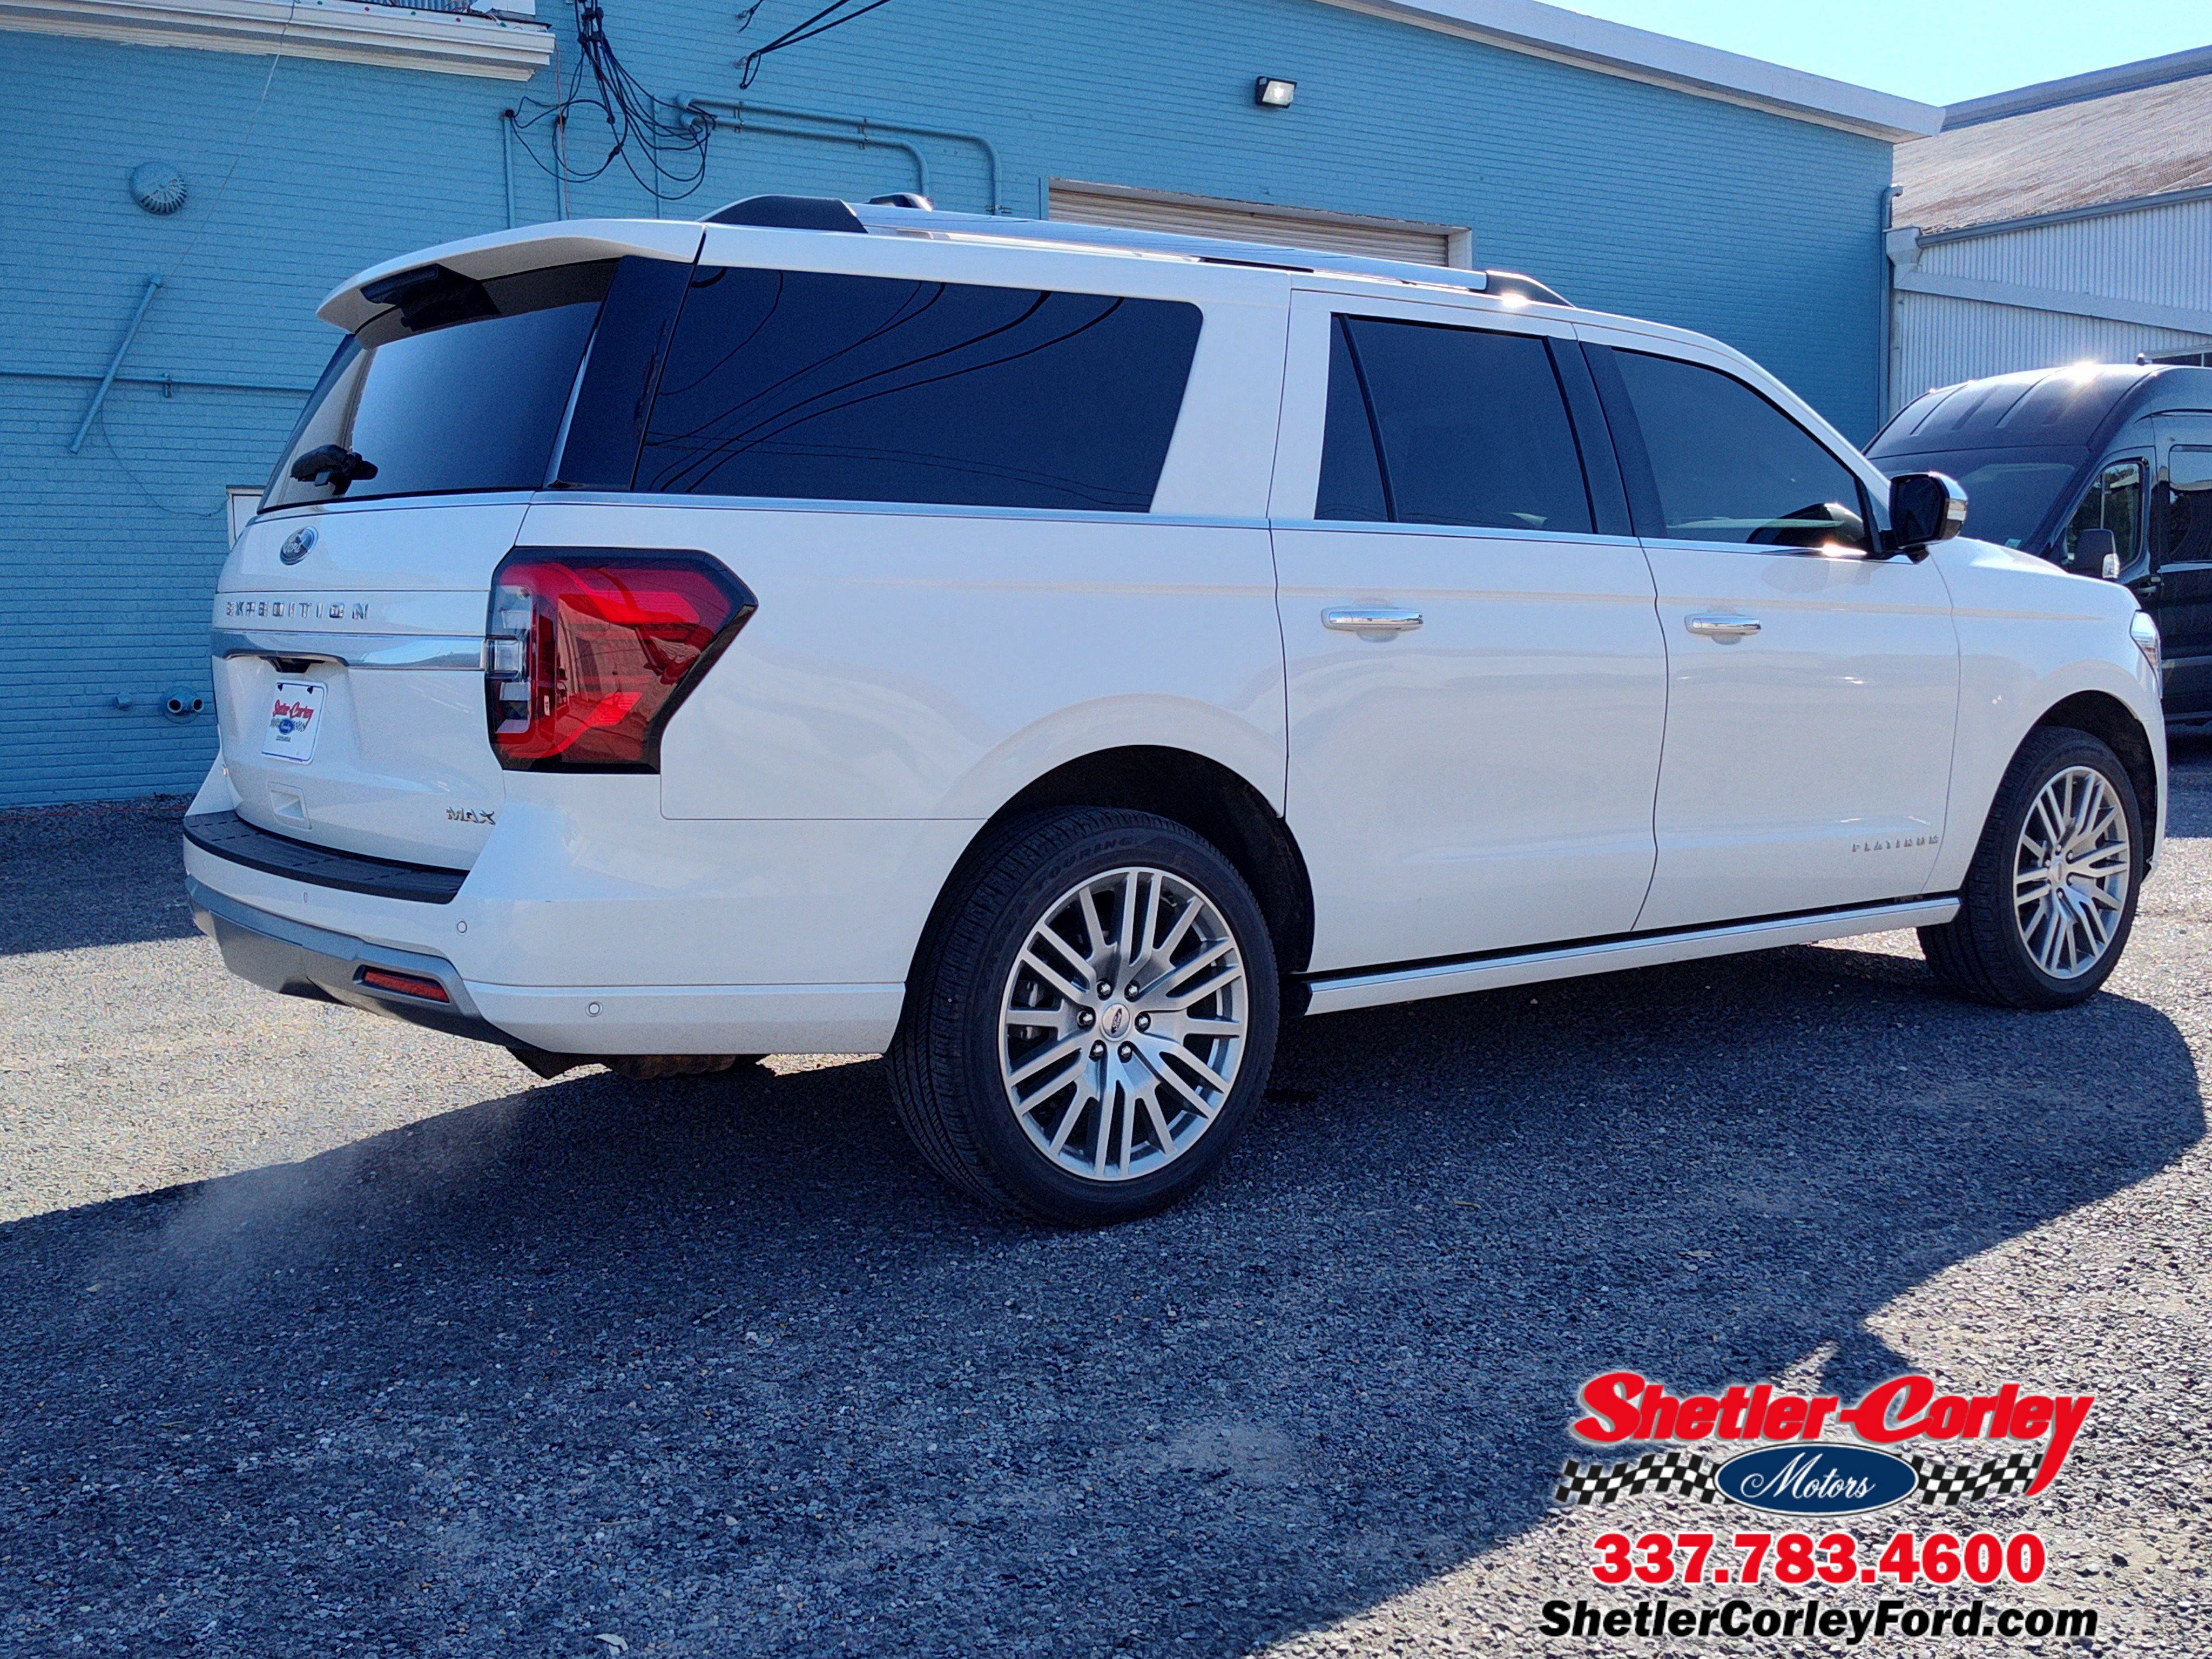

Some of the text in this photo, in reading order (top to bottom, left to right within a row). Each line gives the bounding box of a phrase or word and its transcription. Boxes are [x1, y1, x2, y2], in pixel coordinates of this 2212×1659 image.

[226, 601, 369, 619] EXPEDITION
[446, 806, 496, 825] MAX
[1852, 835, 1938, 852] PLATINUM
